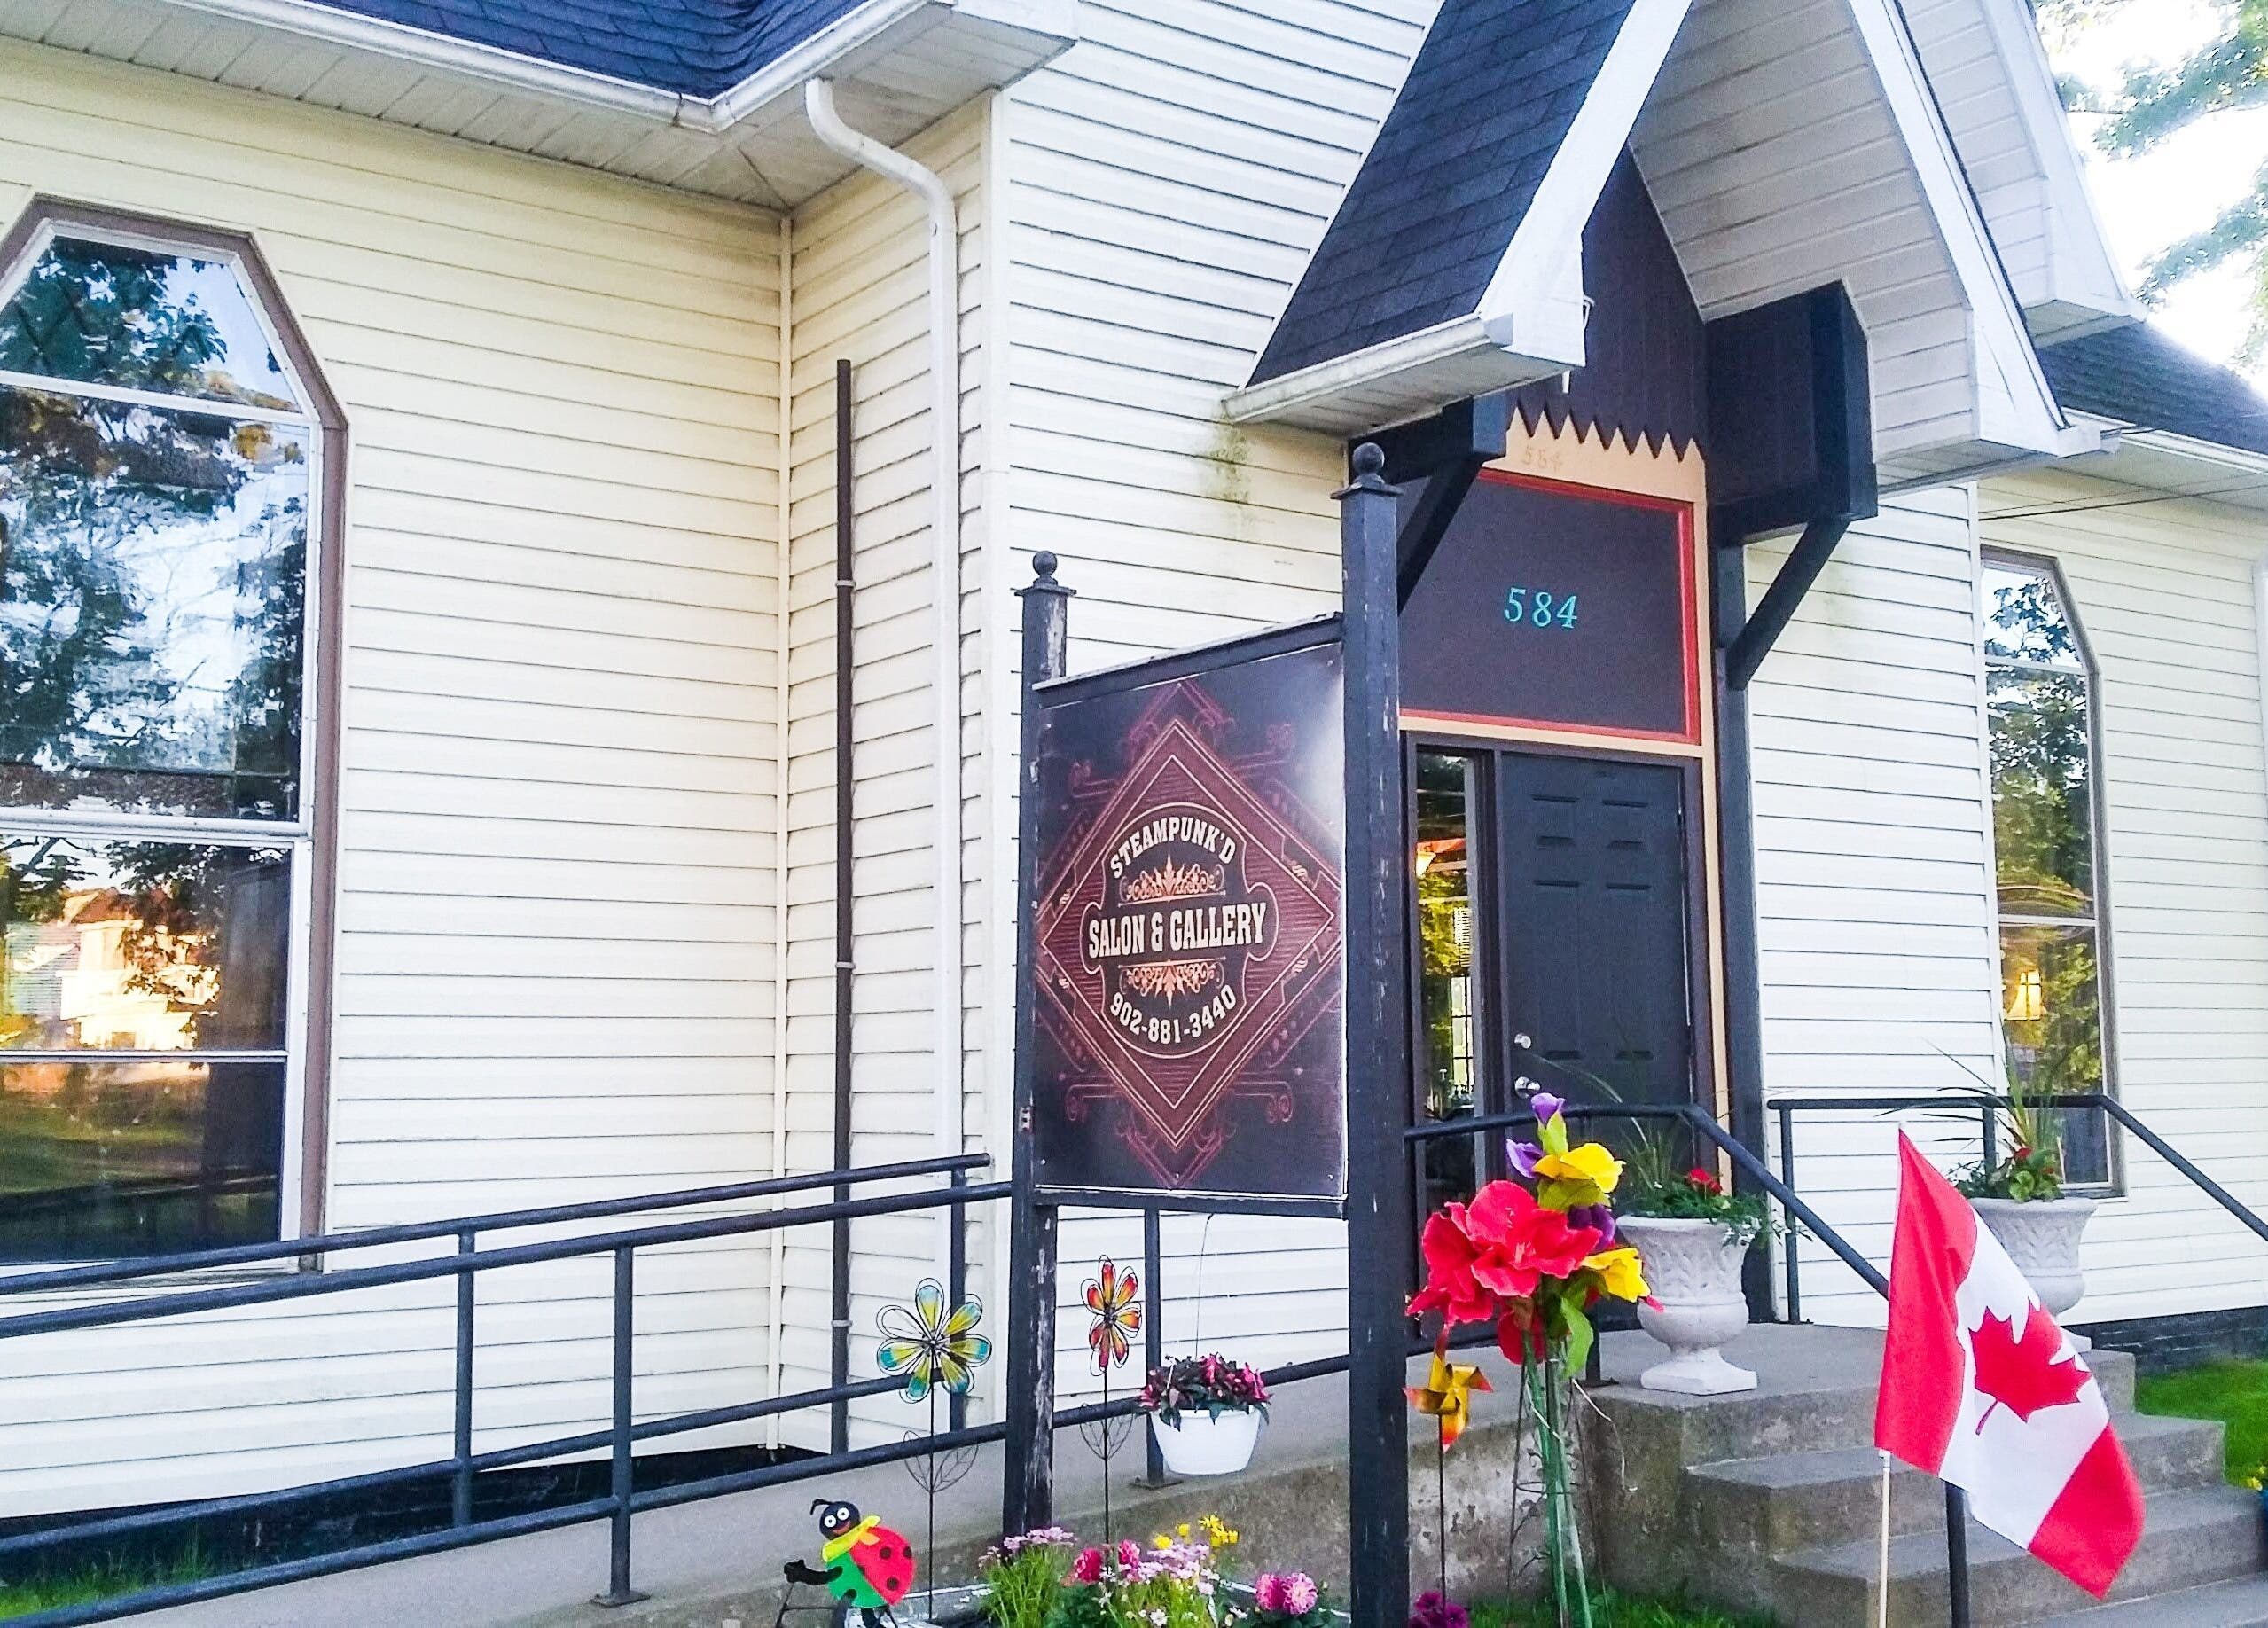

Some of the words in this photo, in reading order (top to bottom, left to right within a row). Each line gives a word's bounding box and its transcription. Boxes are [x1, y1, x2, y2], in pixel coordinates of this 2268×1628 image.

[1505, 587, 1577, 629] 584
[1110, 817, 1236, 878] STEAMPUNK'D
[1088, 914, 1146, 959] SALON
[1151, 912, 1163, 951] &
[1169, 902, 1267, 951] GALLERY
[1110, 984, 1237, 1045] 902-881-3440
